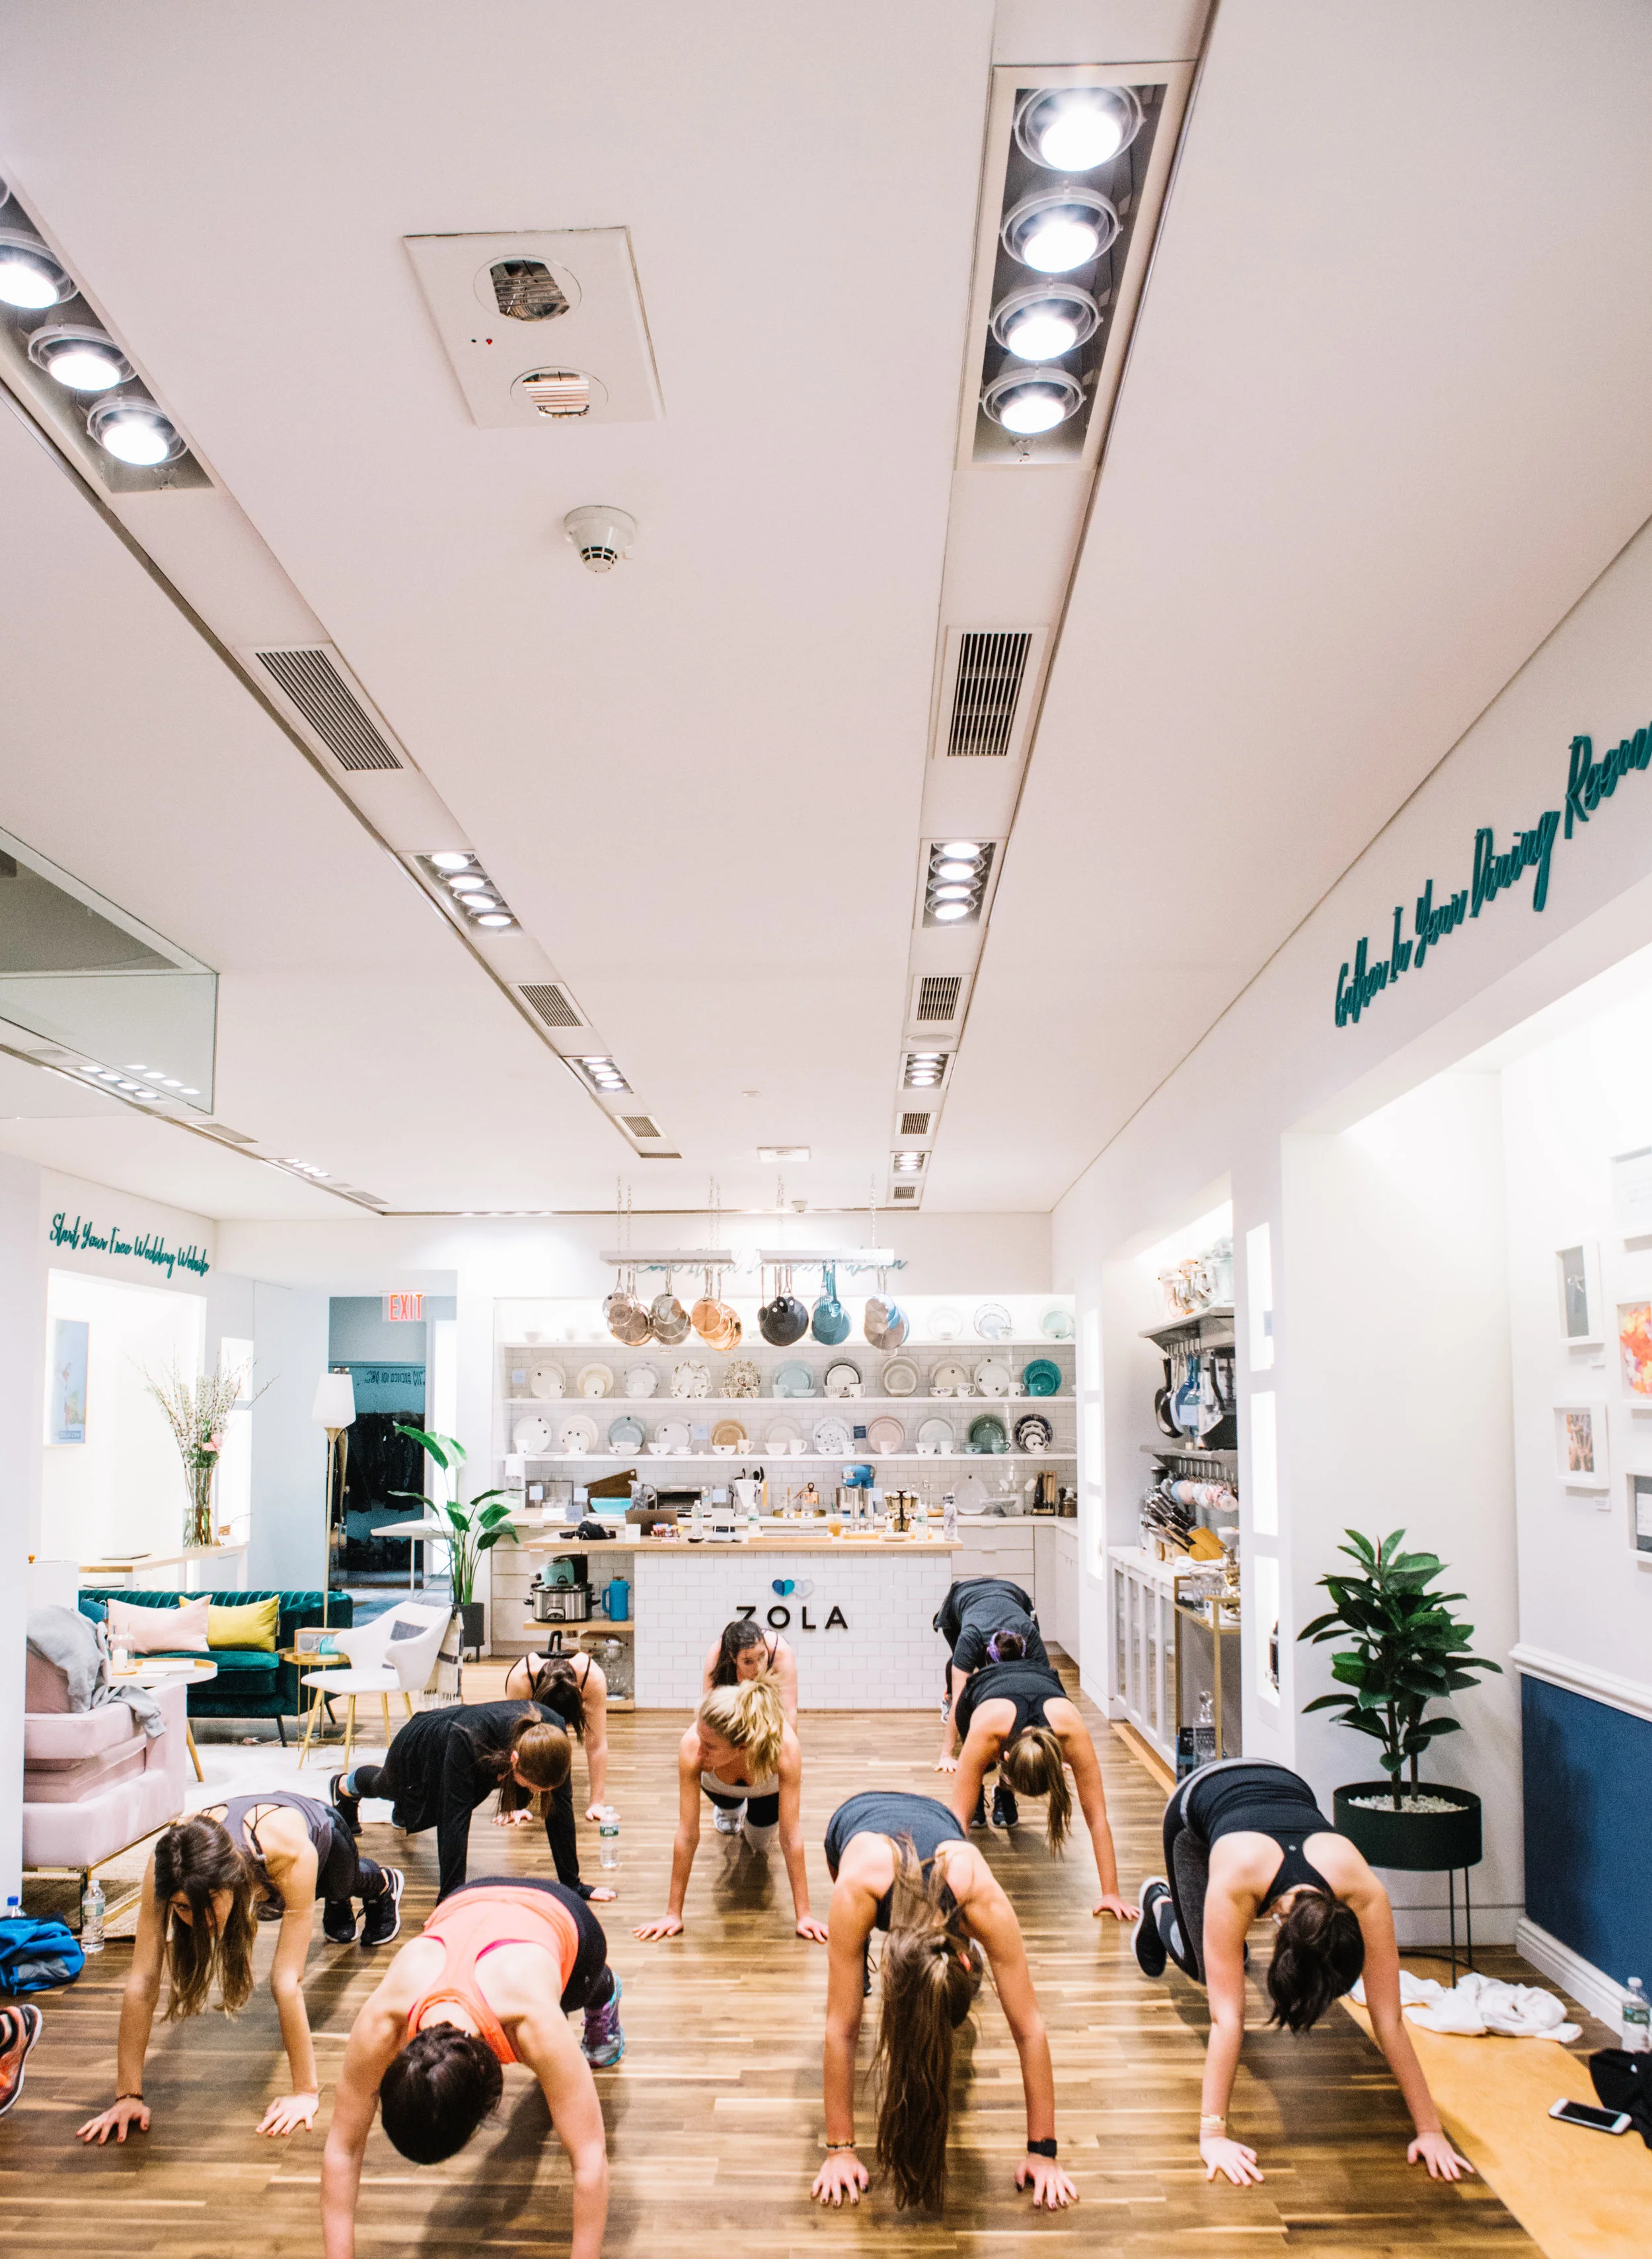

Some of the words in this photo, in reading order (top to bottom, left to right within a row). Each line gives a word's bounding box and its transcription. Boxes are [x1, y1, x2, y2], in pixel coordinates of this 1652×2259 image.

[1335, 937, 1389, 1027] Gather
[1388, 906, 1413, 983] In
[1414, 879, 1468, 968] Your
[1470, 811, 1561, 918] Dining
[50, 1212, 80, 1250] Start
[80, 1221, 108, 1250] Your
[108, 1227, 132, 1255] Free
[133, 1233, 176, 1280] Wedding
[177, 1245, 209, 1277] Website
[389, 1294, 423, 1321] EXIT
[736, 1605, 848, 1629] ZOLA
